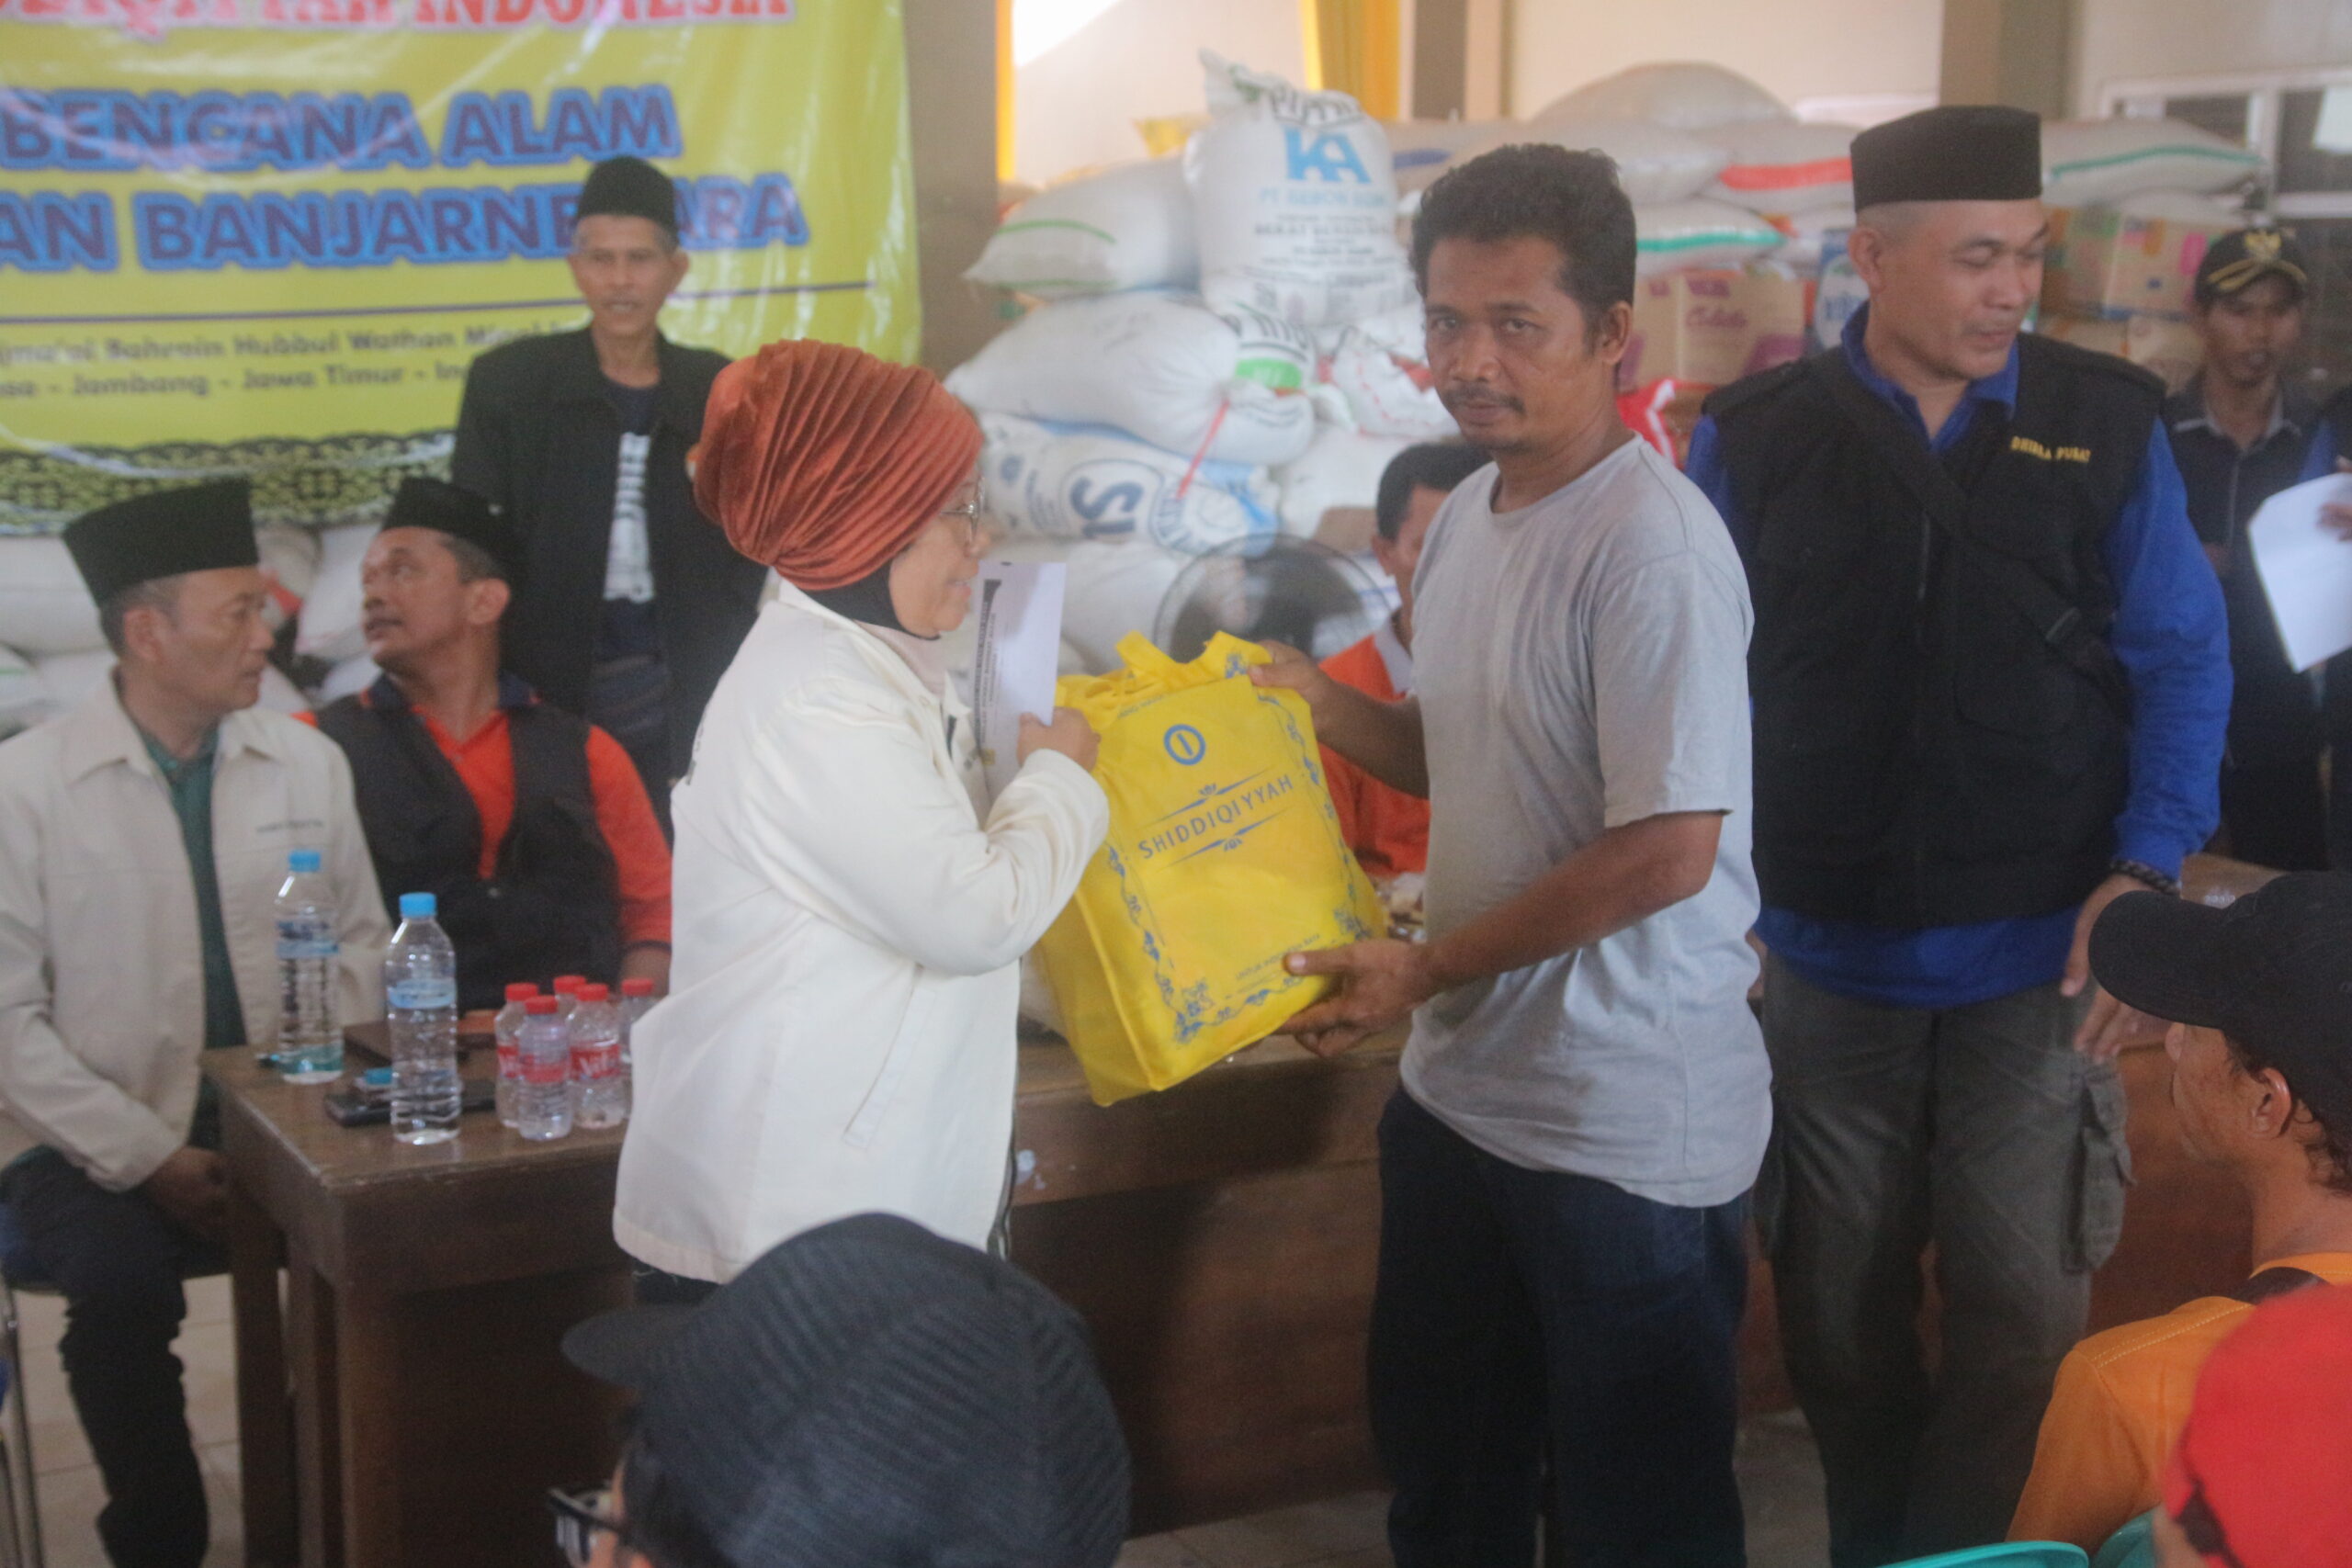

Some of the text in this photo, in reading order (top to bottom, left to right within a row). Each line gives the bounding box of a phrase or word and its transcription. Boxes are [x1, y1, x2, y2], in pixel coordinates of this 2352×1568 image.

[444, 89, 680, 164] ALAM
[138, 178, 805, 265] BANJARNERA
[1138, 773, 1295, 861] SHIDDIQIYYAH
